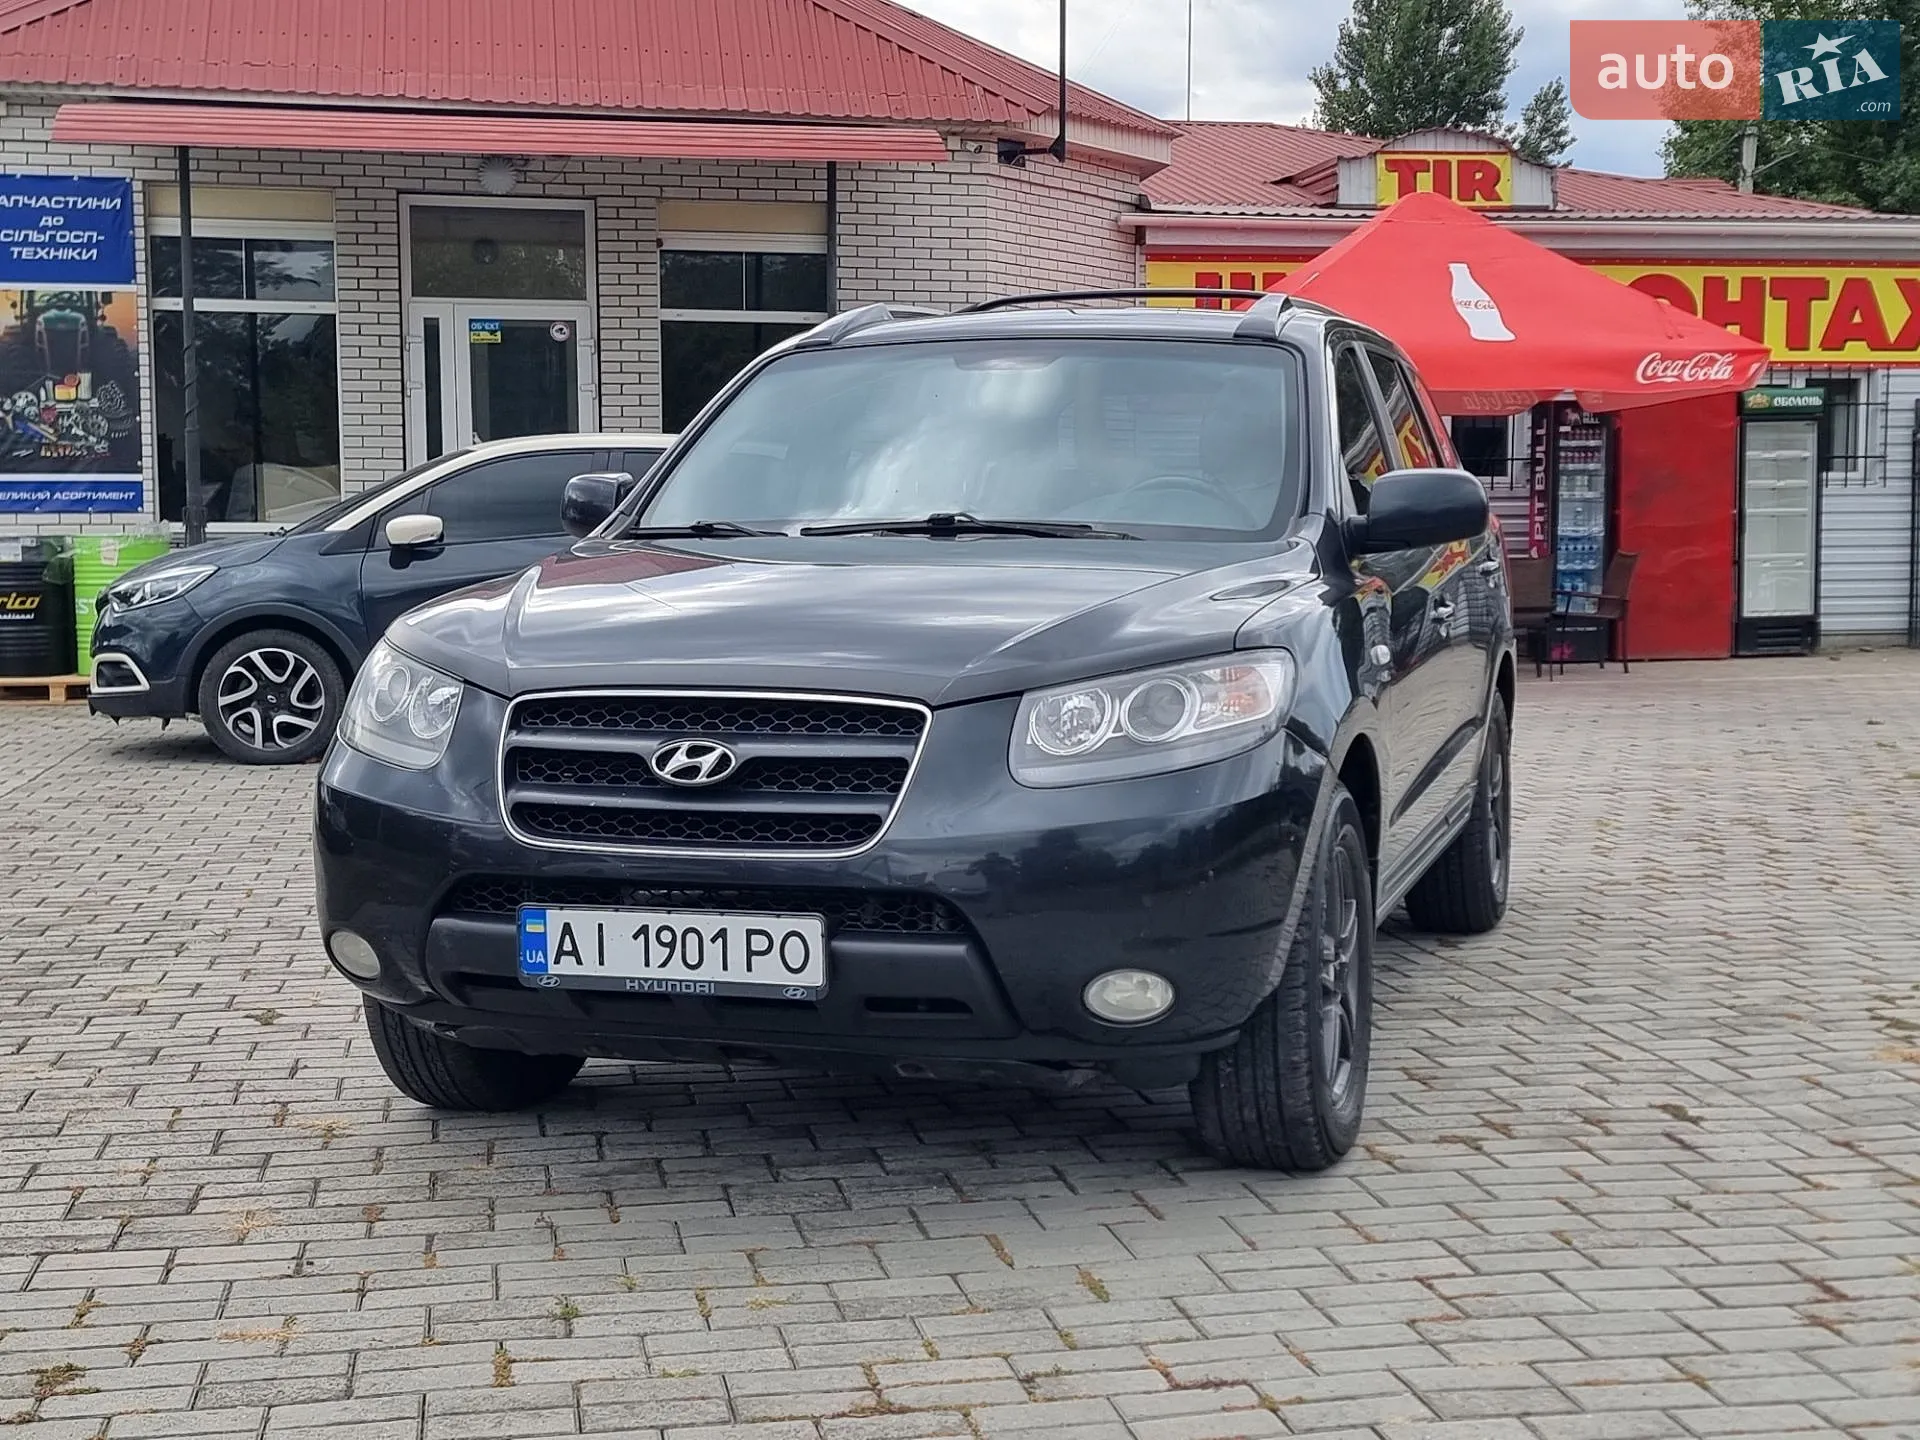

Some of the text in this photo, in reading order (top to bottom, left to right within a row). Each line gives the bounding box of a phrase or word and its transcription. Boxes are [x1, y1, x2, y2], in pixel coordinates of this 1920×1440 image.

[1384, 158, 1503, 202] TIR
[0, 230, 105, 243] СІЛЬГОСП-
[10, 247, 97, 260] ТЕХНІКИ
[1635, 352, 1737, 384] Coca-Cola
[1535, 418, 1547, 490] BULL
[53, 491, 136, 500] АСОРТИМЕНТ
[1534, 495, 1545, 540] PIT
[526, 949, 546, 964] UA
[553, 922, 811, 975] AI 1901 PO
[626, 978, 715, 994] HYUNDAI
